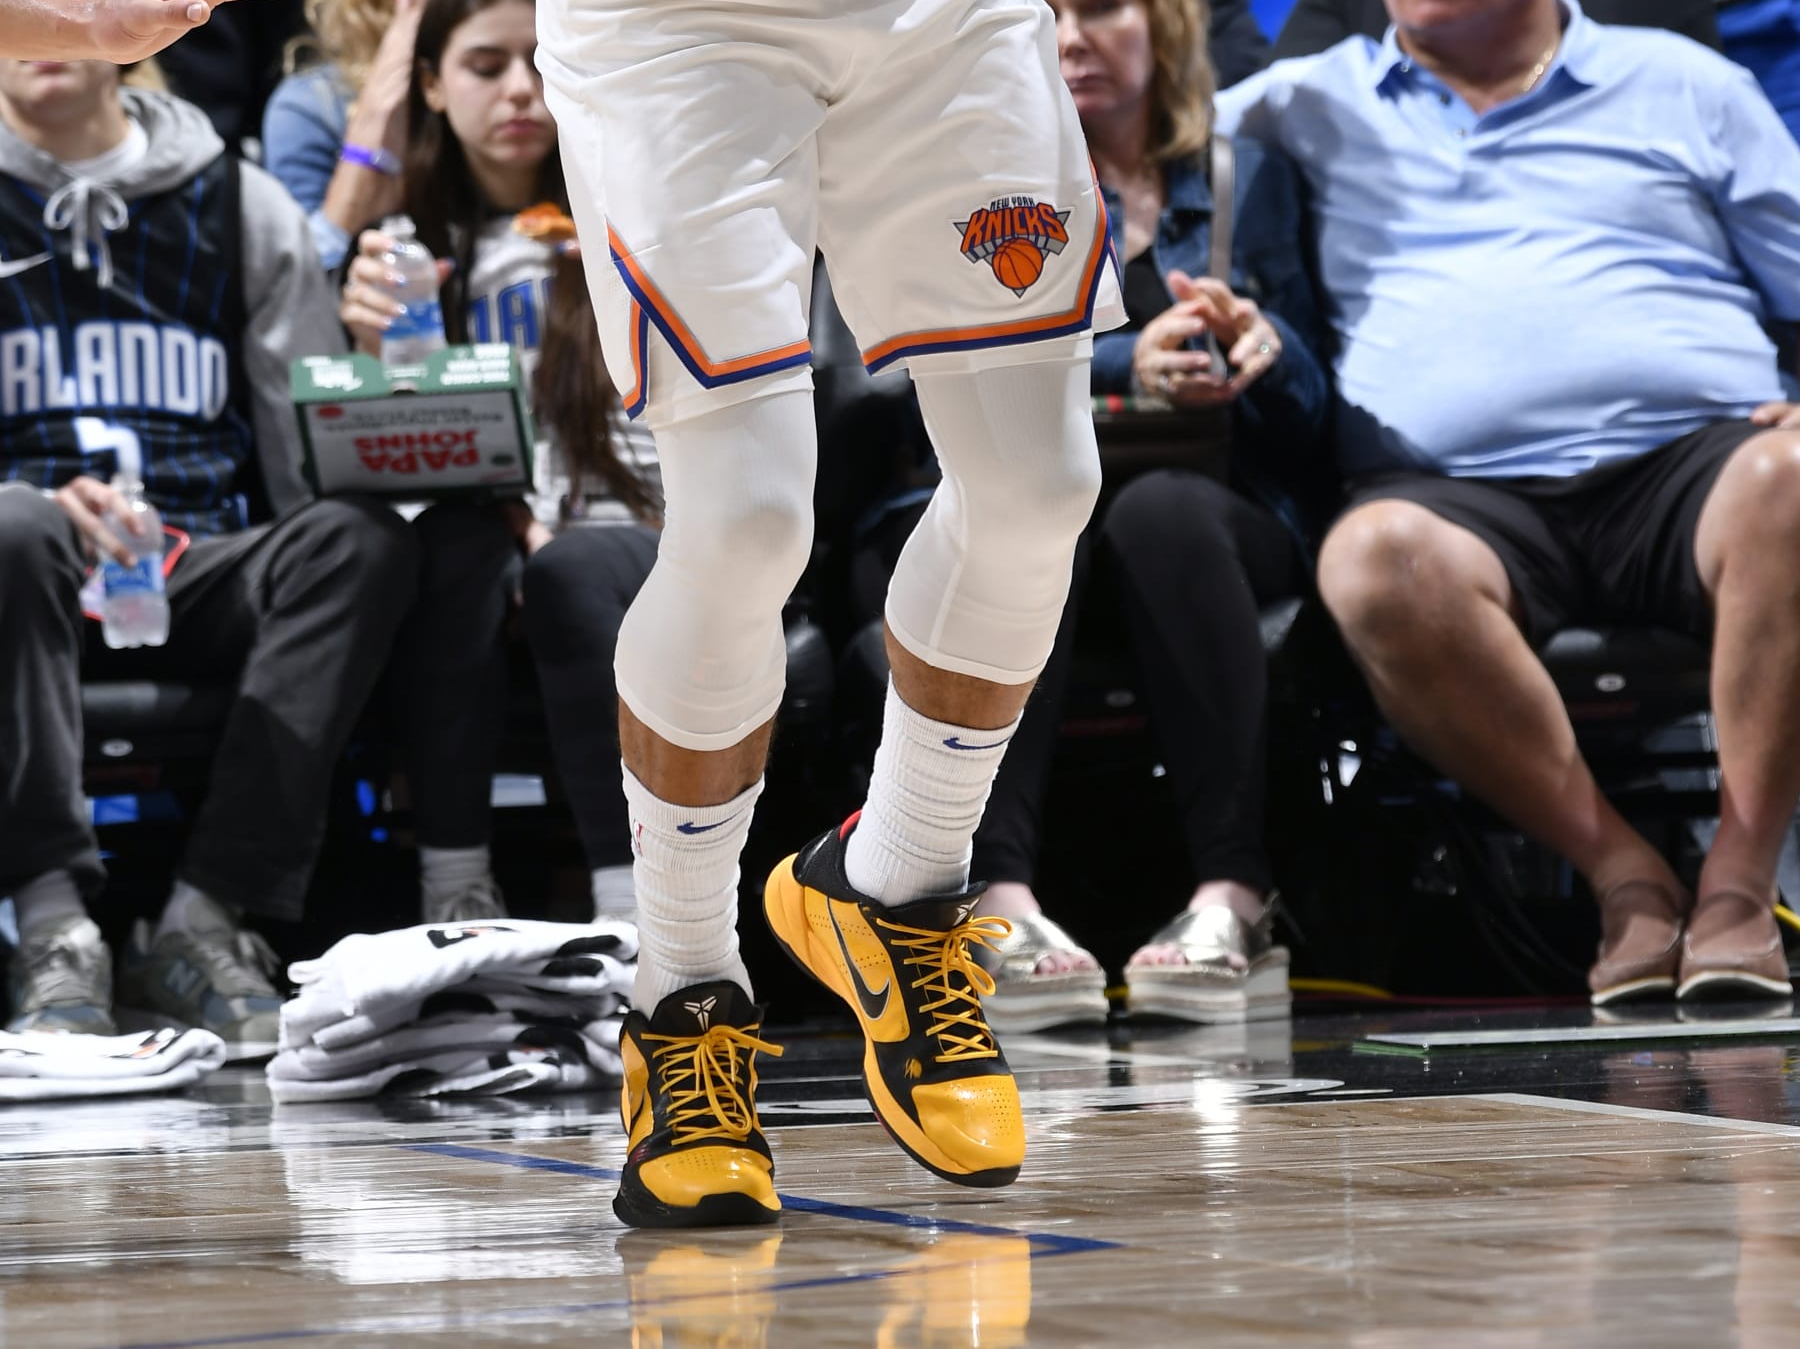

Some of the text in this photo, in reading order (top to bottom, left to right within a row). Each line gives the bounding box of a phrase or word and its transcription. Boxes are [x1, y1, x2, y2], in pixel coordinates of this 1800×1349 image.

[989, 196, 1036, 210] NEW YORK
[960, 202, 1069, 256] KNICKS
[0, 321, 228, 421] RLANDO
[353, 427, 479, 453] JOHNS
[359, 447, 481, 474] PAPA
